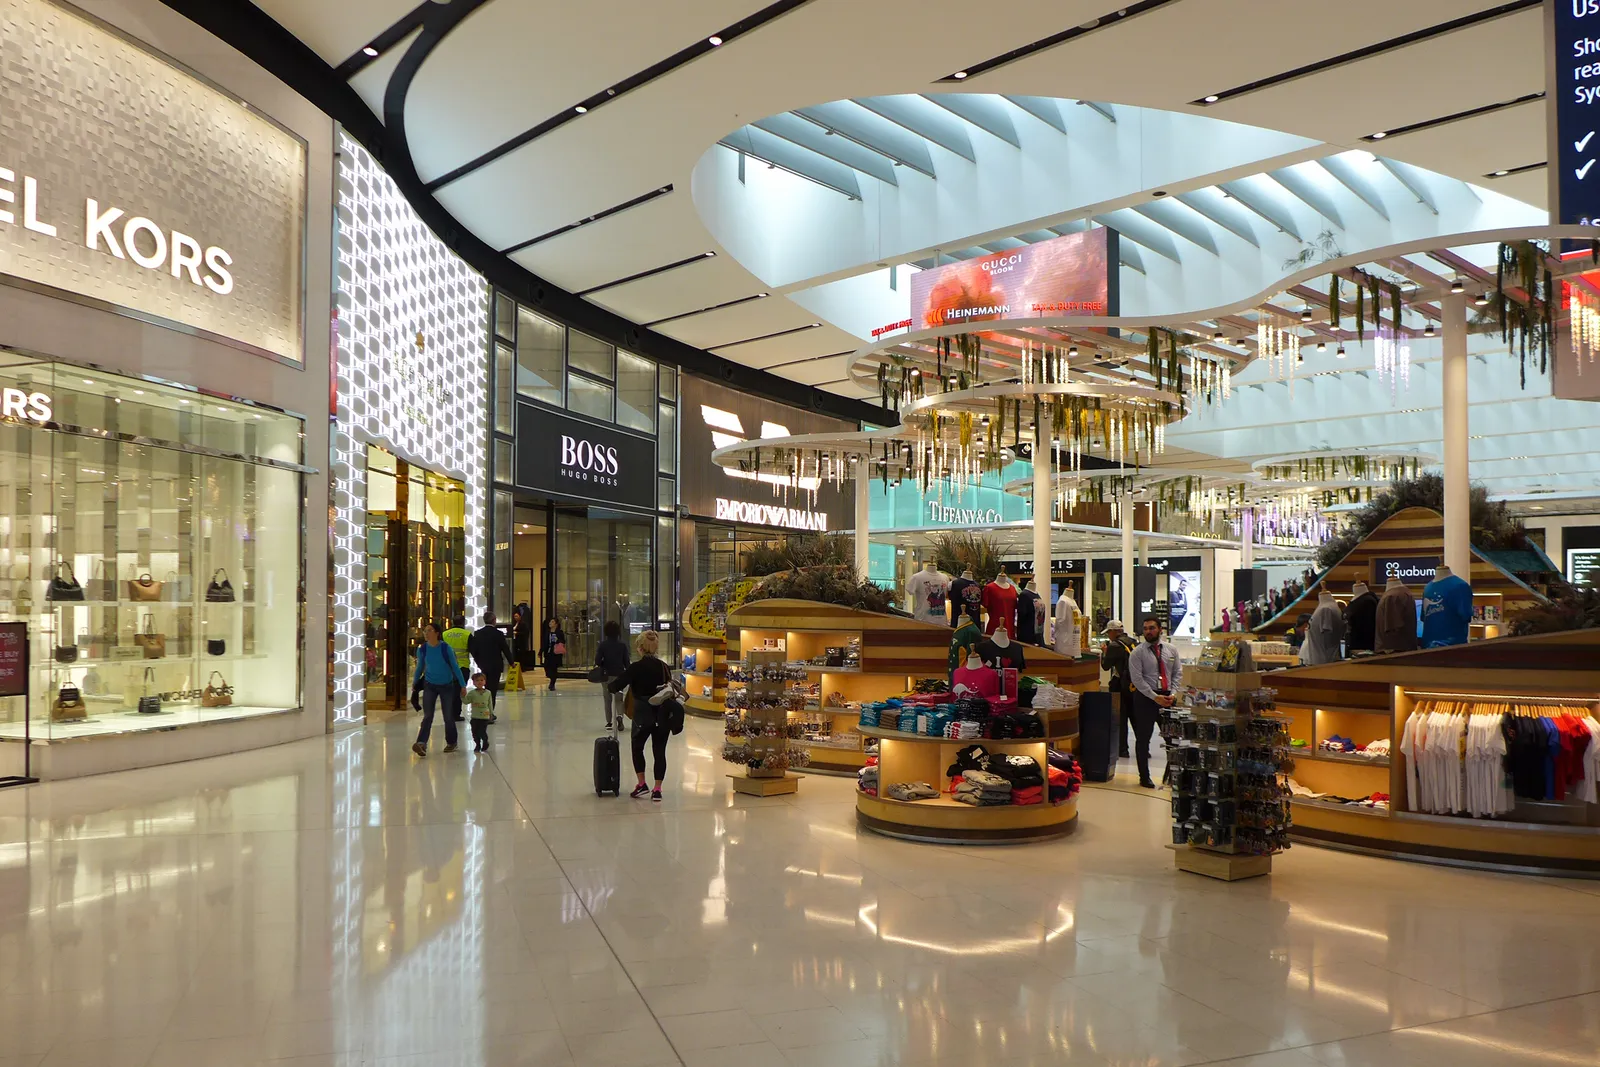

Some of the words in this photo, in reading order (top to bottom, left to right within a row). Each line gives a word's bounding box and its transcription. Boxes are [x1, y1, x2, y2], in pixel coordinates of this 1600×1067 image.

[86, 198, 234, 295] KORS
[981, 254, 1022, 271] GUCCI
[947, 304, 1011, 319] HEINEMANN
[1058, 301, 1080, 311] DUTY
[1082, 301, 1102, 310] FREE
[561, 434, 618, 476] BOSS
[561, 468, 588, 481] HUGO
[593, 474, 618, 487] BOSS
[716, 497, 767, 525] EMPORIO
[780, 507, 828, 532] ARMANI
[1019, 560, 1074, 570] KAIS
